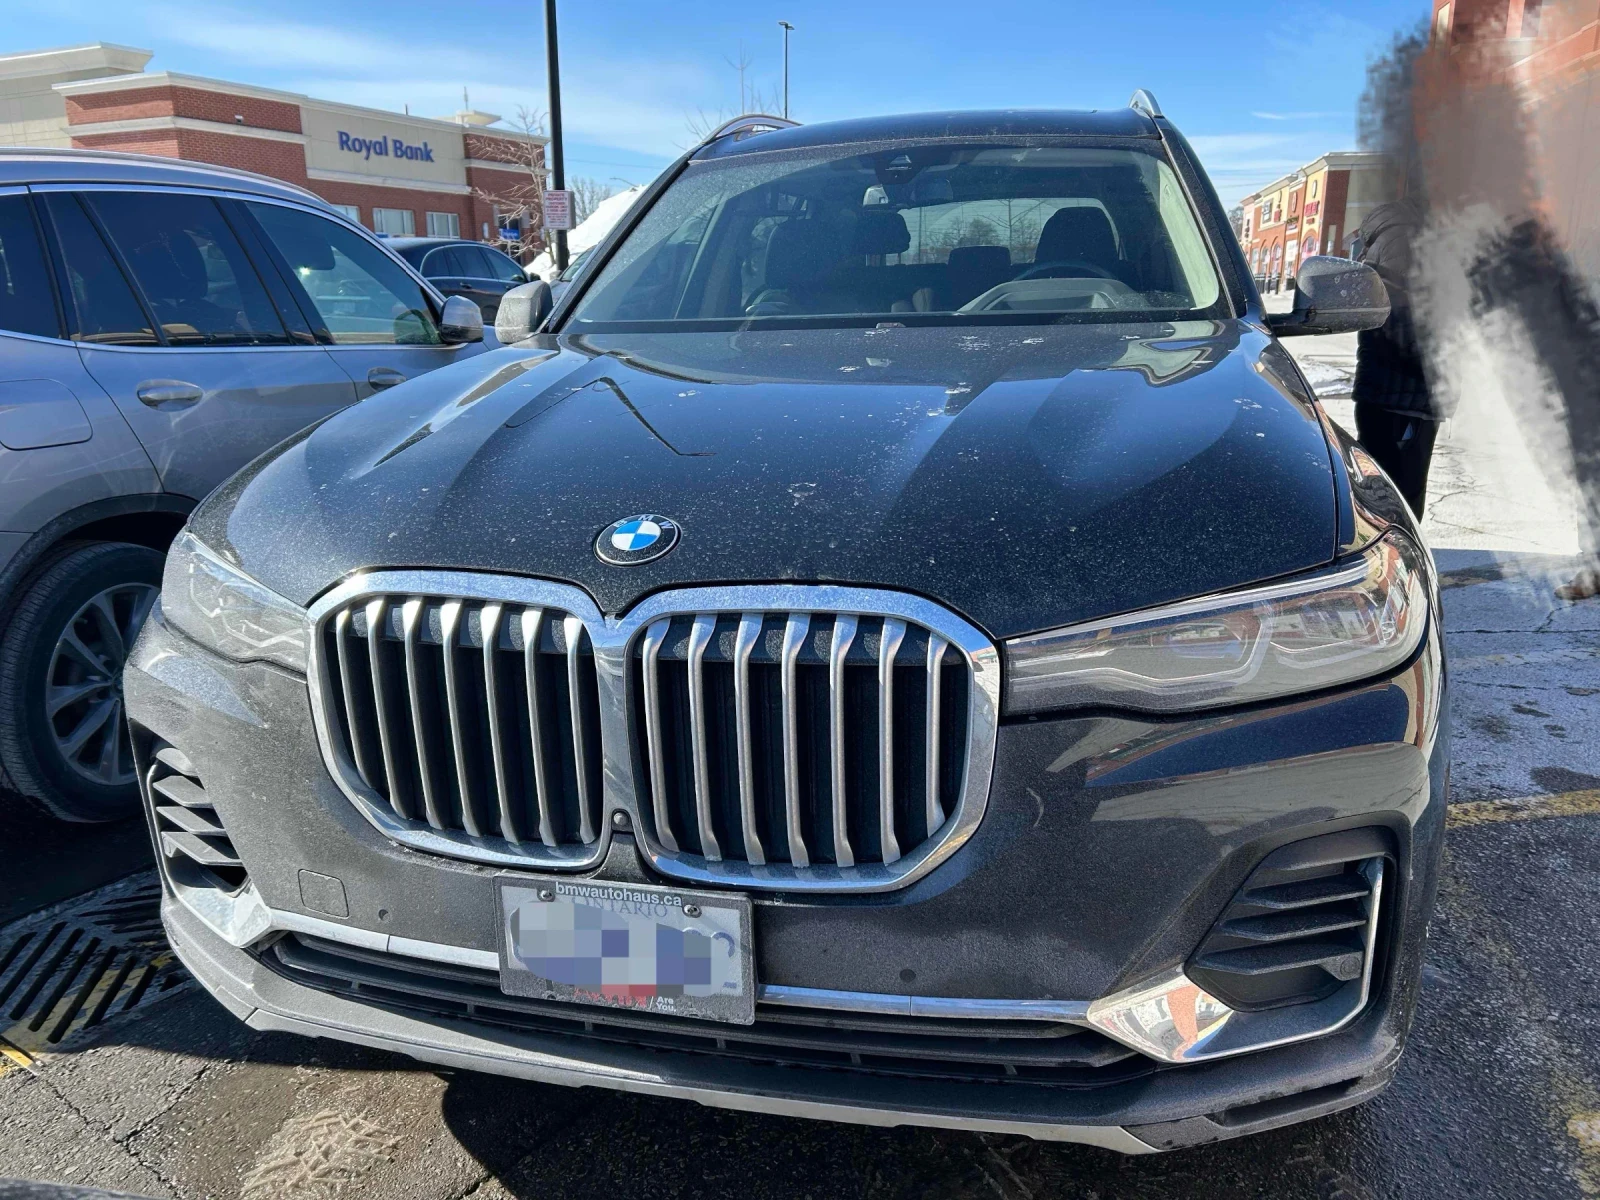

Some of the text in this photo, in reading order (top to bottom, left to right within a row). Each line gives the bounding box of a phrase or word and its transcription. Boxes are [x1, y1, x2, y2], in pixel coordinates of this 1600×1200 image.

[337, 130, 435, 162] Royal Bank
[555, 882, 682, 907] bmwautohaus.ca
[656, 1002, 677, 1012] You.
[657, 996, 674, 1004] Are
